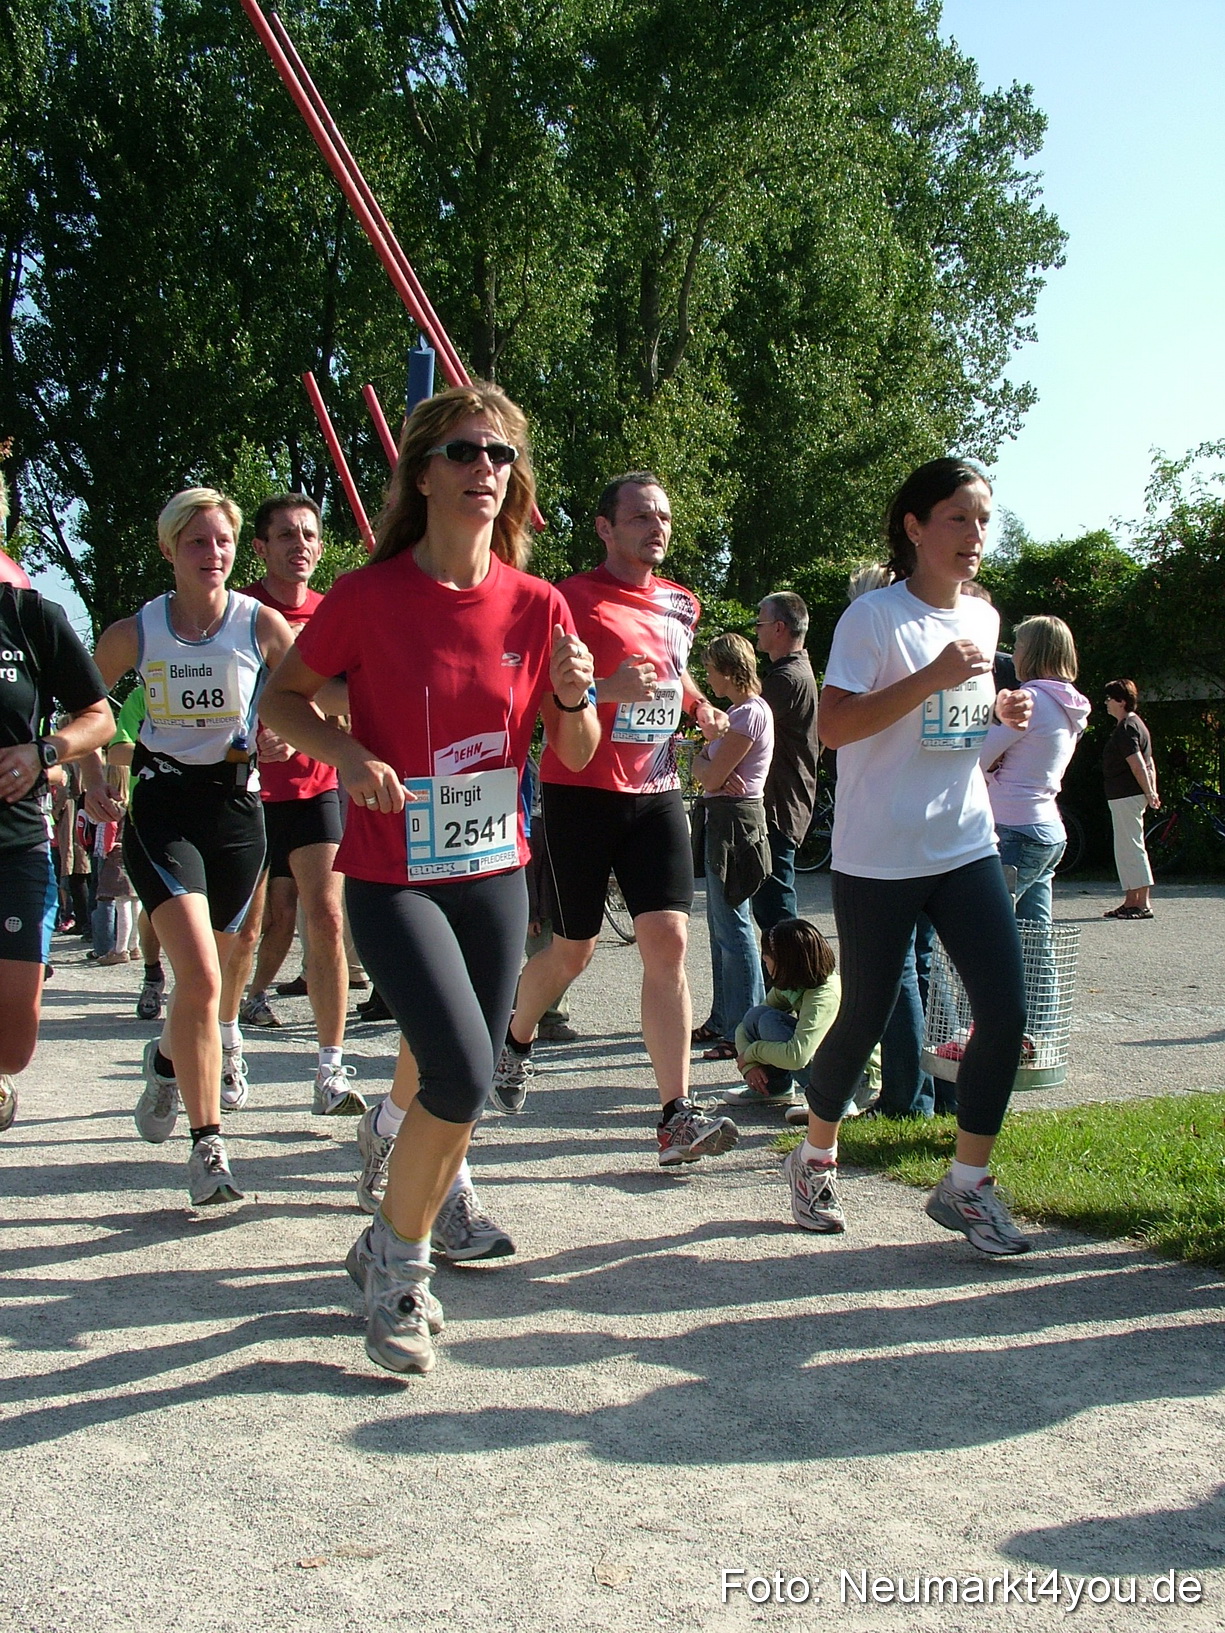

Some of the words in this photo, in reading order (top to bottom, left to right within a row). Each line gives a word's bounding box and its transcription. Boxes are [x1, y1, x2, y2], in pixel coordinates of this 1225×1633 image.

[170, 664, 213, 678] Belinda
[181, 688, 225, 709] 648
[636, 708, 674, 726] 2431
[948, 704, 990, 728] 2149
[454, 741, 483, 764] DEHN
[440, 785, 482, 807] Birgit
[412, 818, 420, 832] D
[444, 813, 507, 849] 2541
[480, 851, 516, 865] PFLEIDERER
[410, 863, 455, 876] BOCK
